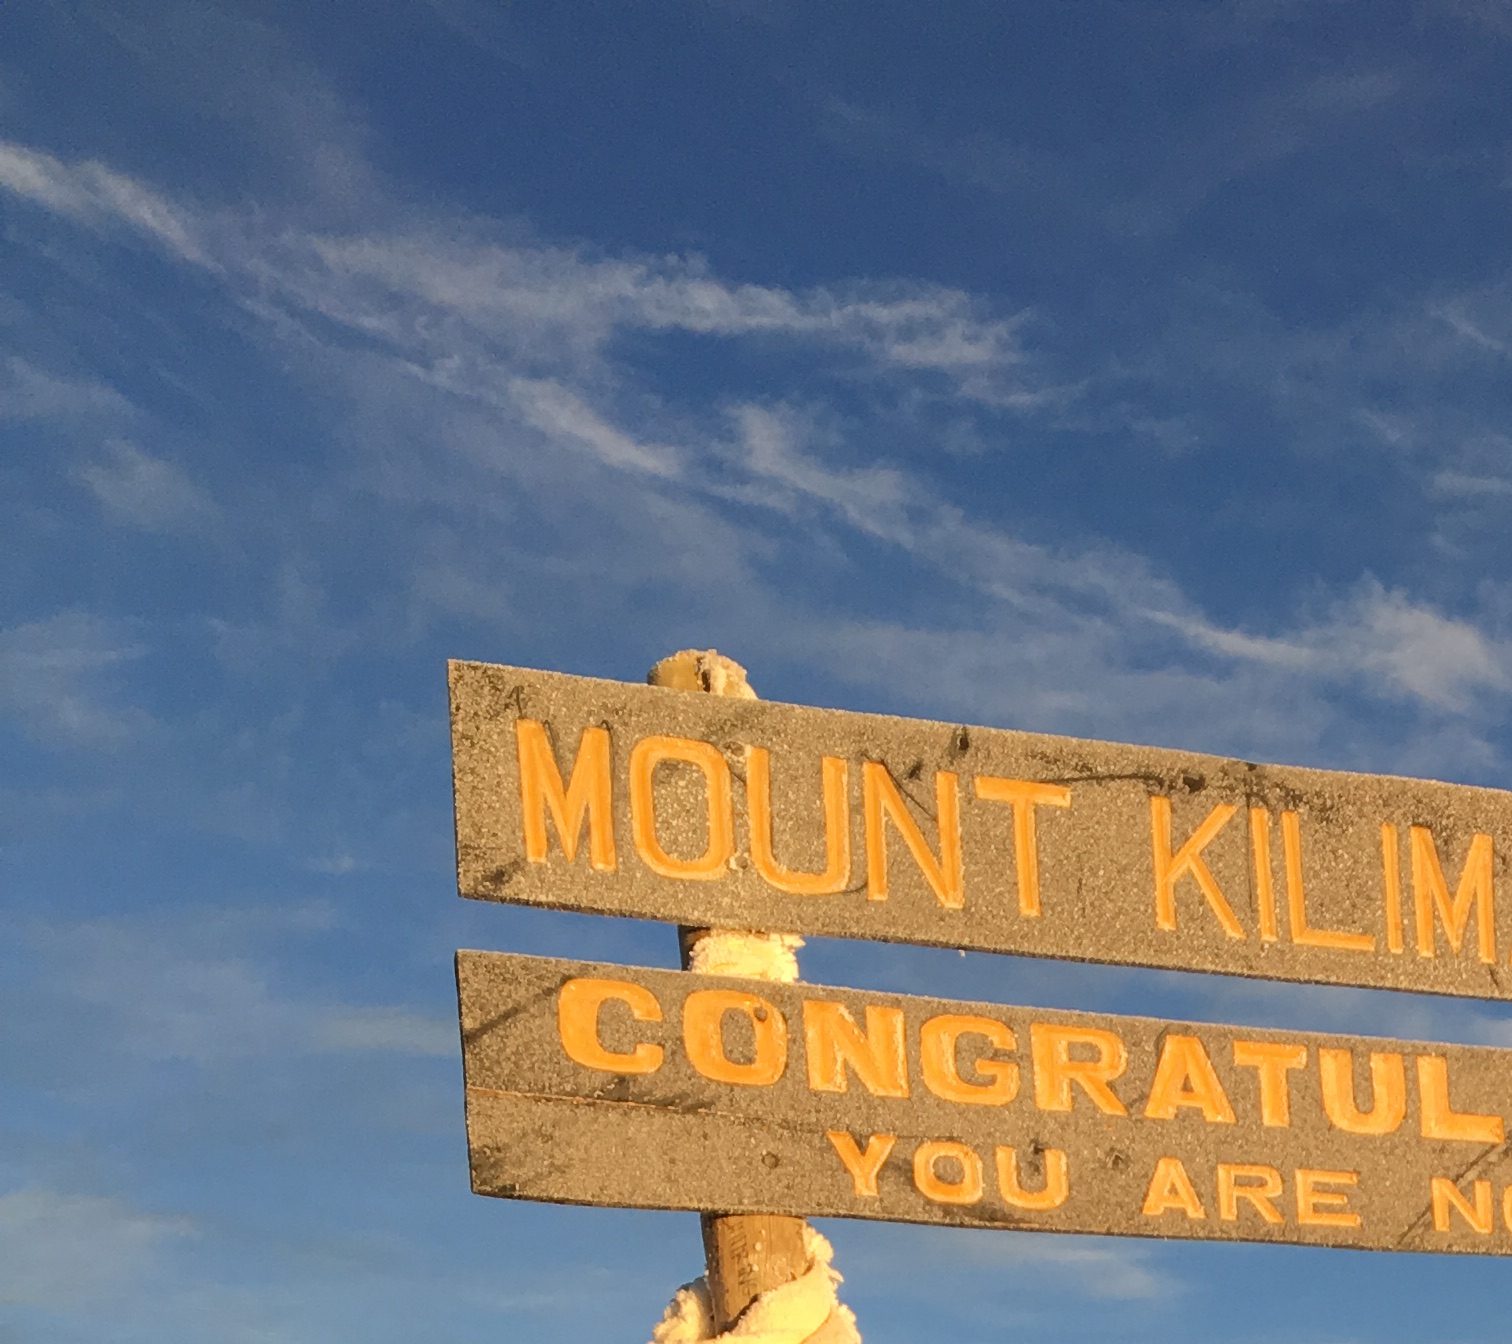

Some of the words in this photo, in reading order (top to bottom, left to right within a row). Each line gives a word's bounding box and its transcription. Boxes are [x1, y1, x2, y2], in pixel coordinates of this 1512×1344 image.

[515, 718, 1073, 917] MOUNT
[827, 1130, 1069, 1210] YOU
[1143, 1157, 1361, 1227] ARE
